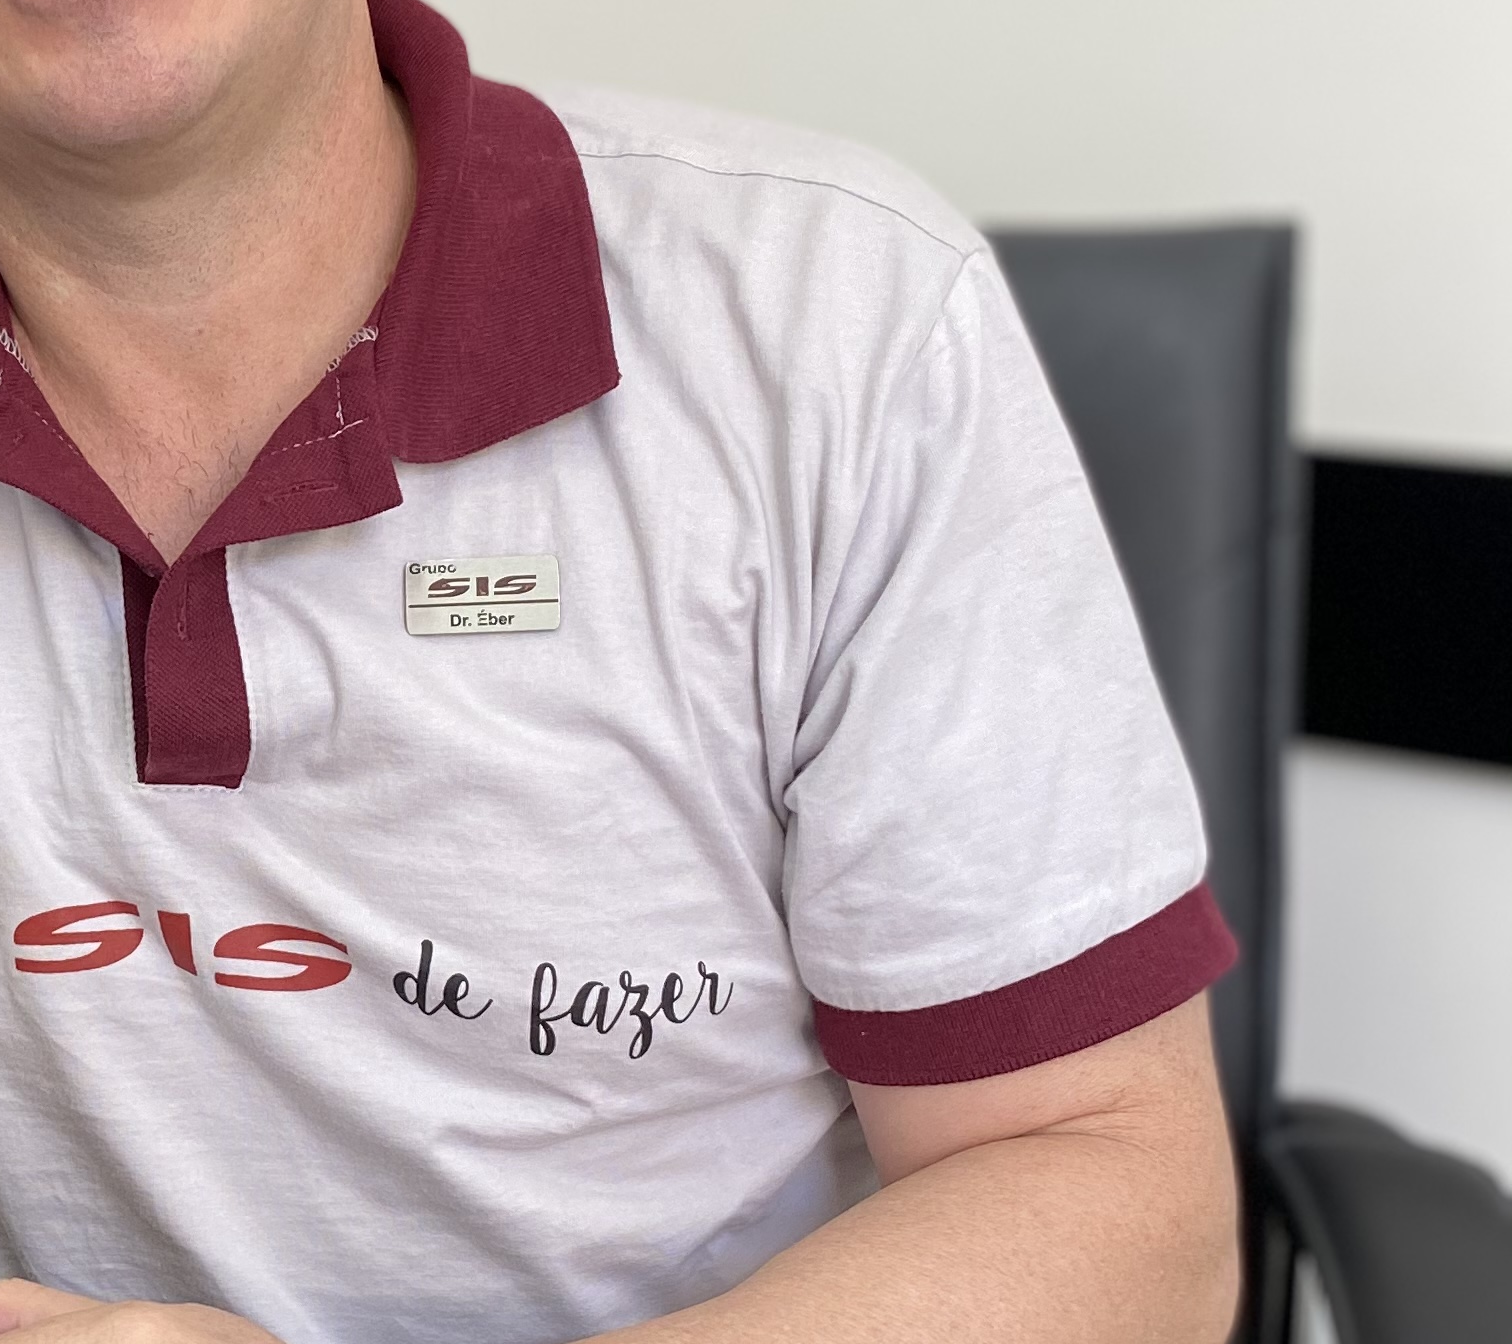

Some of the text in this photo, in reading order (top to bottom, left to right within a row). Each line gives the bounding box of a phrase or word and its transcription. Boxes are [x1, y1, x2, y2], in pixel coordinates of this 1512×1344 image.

[427, 574, 537, 599] SIS
[450, 608, 516, 627] Dr. Éber
[12, 900, 352, 993] SIS
[393, 939, 494, 1020] de
[529, 960, 734, 1060] fazer
